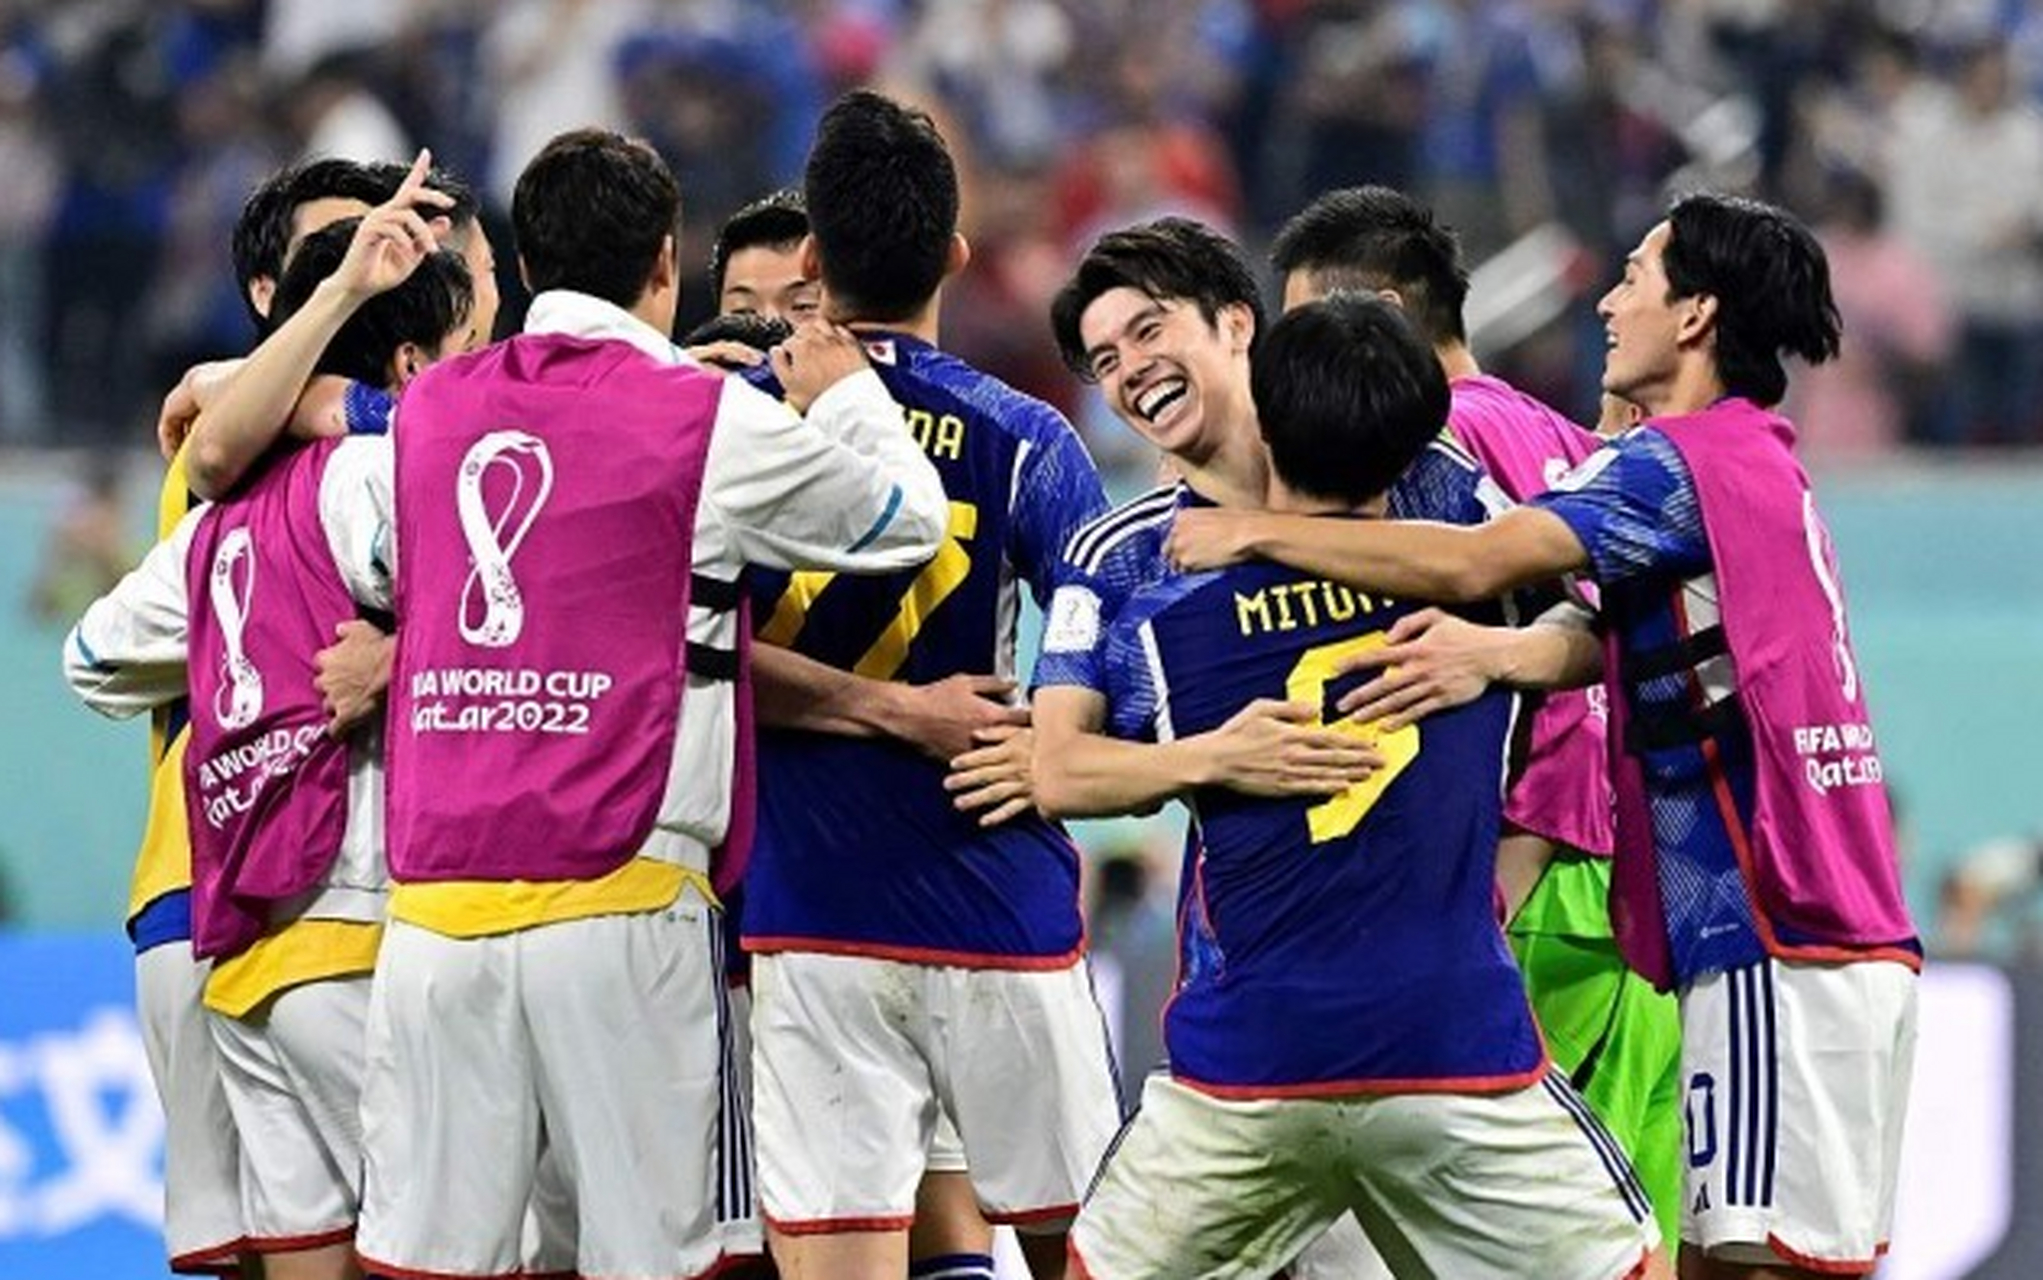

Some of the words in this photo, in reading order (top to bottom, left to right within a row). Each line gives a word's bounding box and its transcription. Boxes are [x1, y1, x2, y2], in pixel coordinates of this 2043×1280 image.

[441, 668, 540, 697] WORLD
[546, 671, 612, 700] CUP
[412, 701, 589, 736] atar2022
